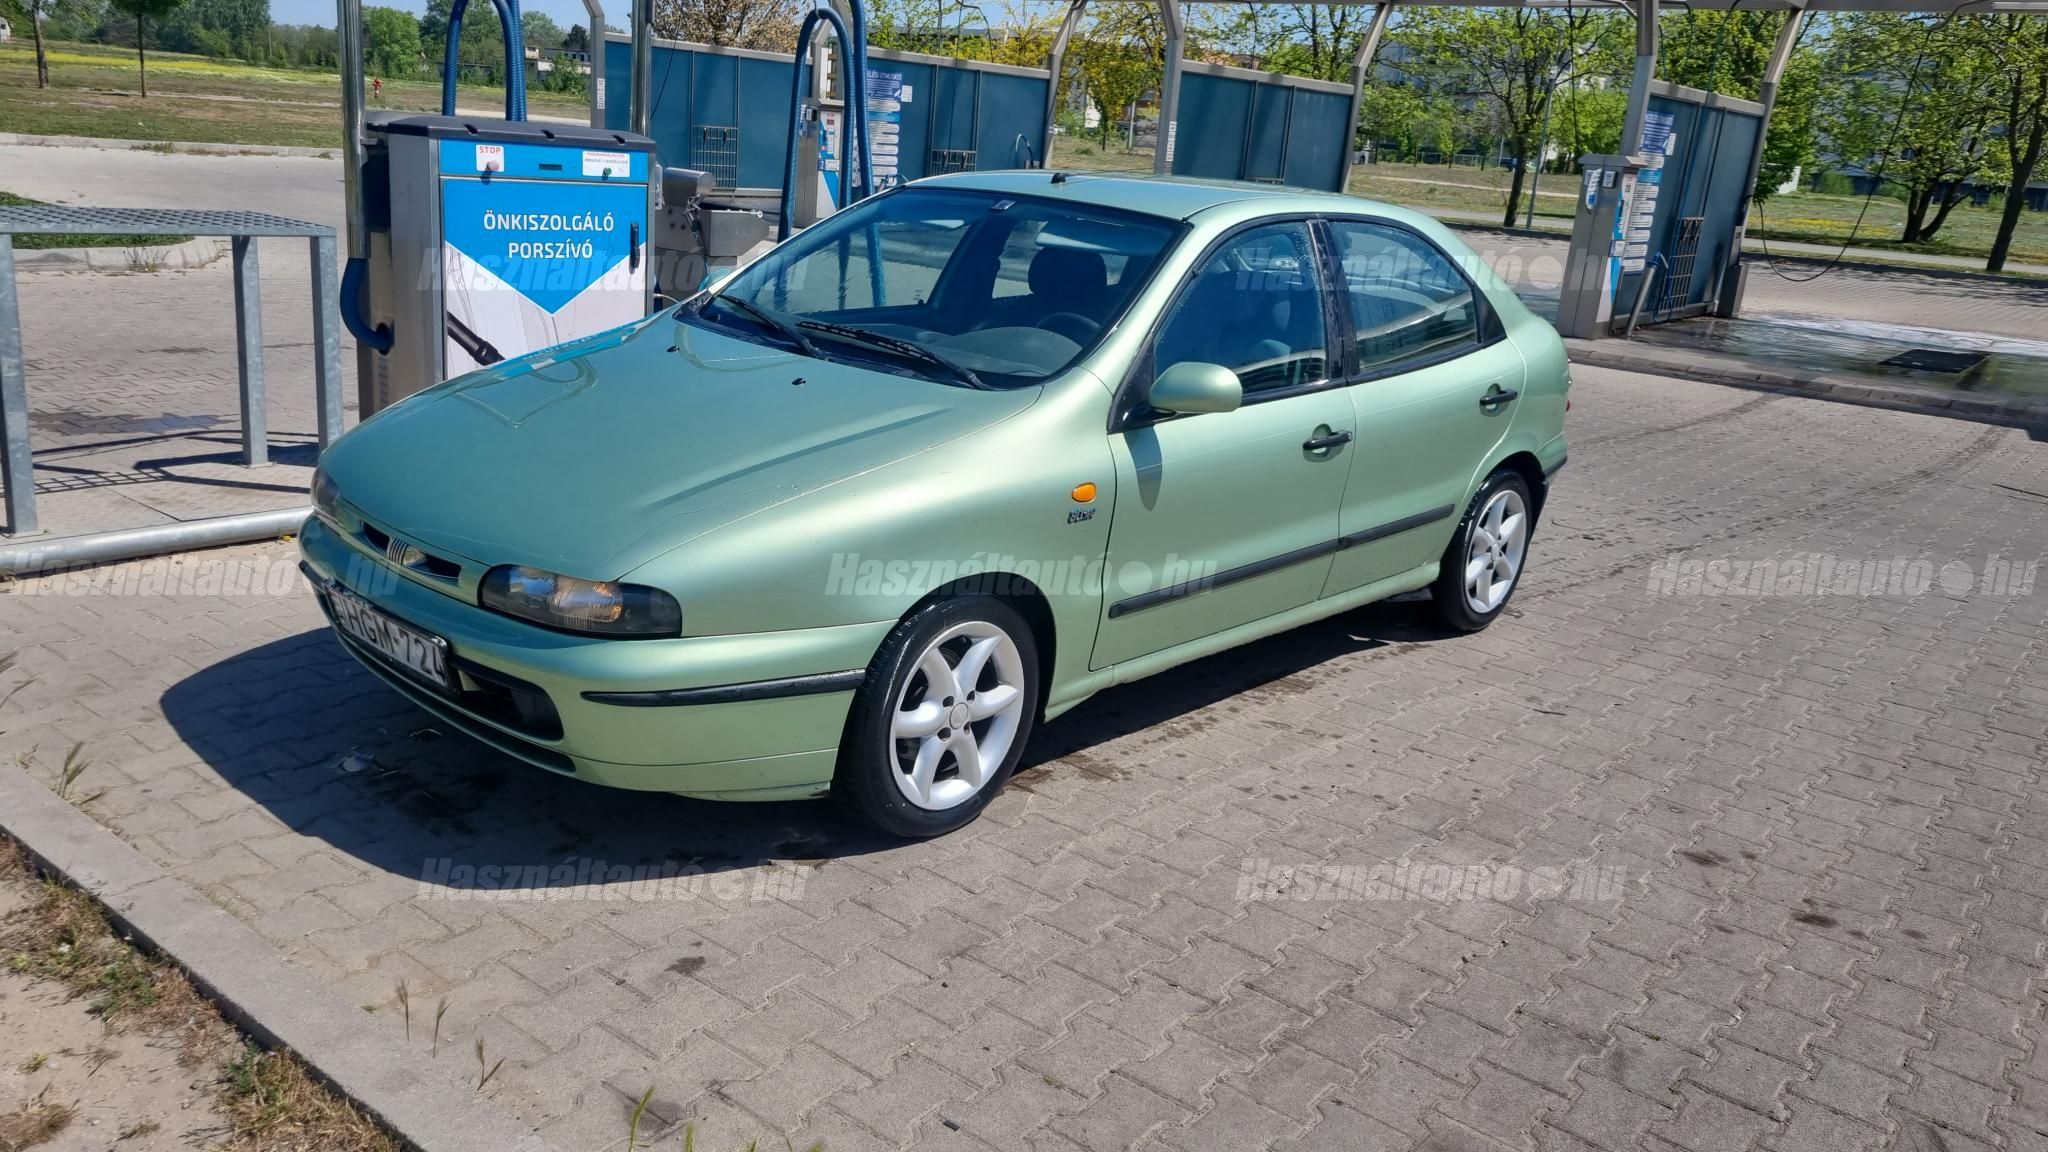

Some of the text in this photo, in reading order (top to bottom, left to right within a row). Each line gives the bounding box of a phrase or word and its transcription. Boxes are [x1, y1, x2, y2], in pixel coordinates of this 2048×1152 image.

[479, 146, 501, 154] STOP
[483, 209, 615, 232] ÖNKISZOLGÁLÓ
[508, 238, 593, 259] PORSZÍVÓ
